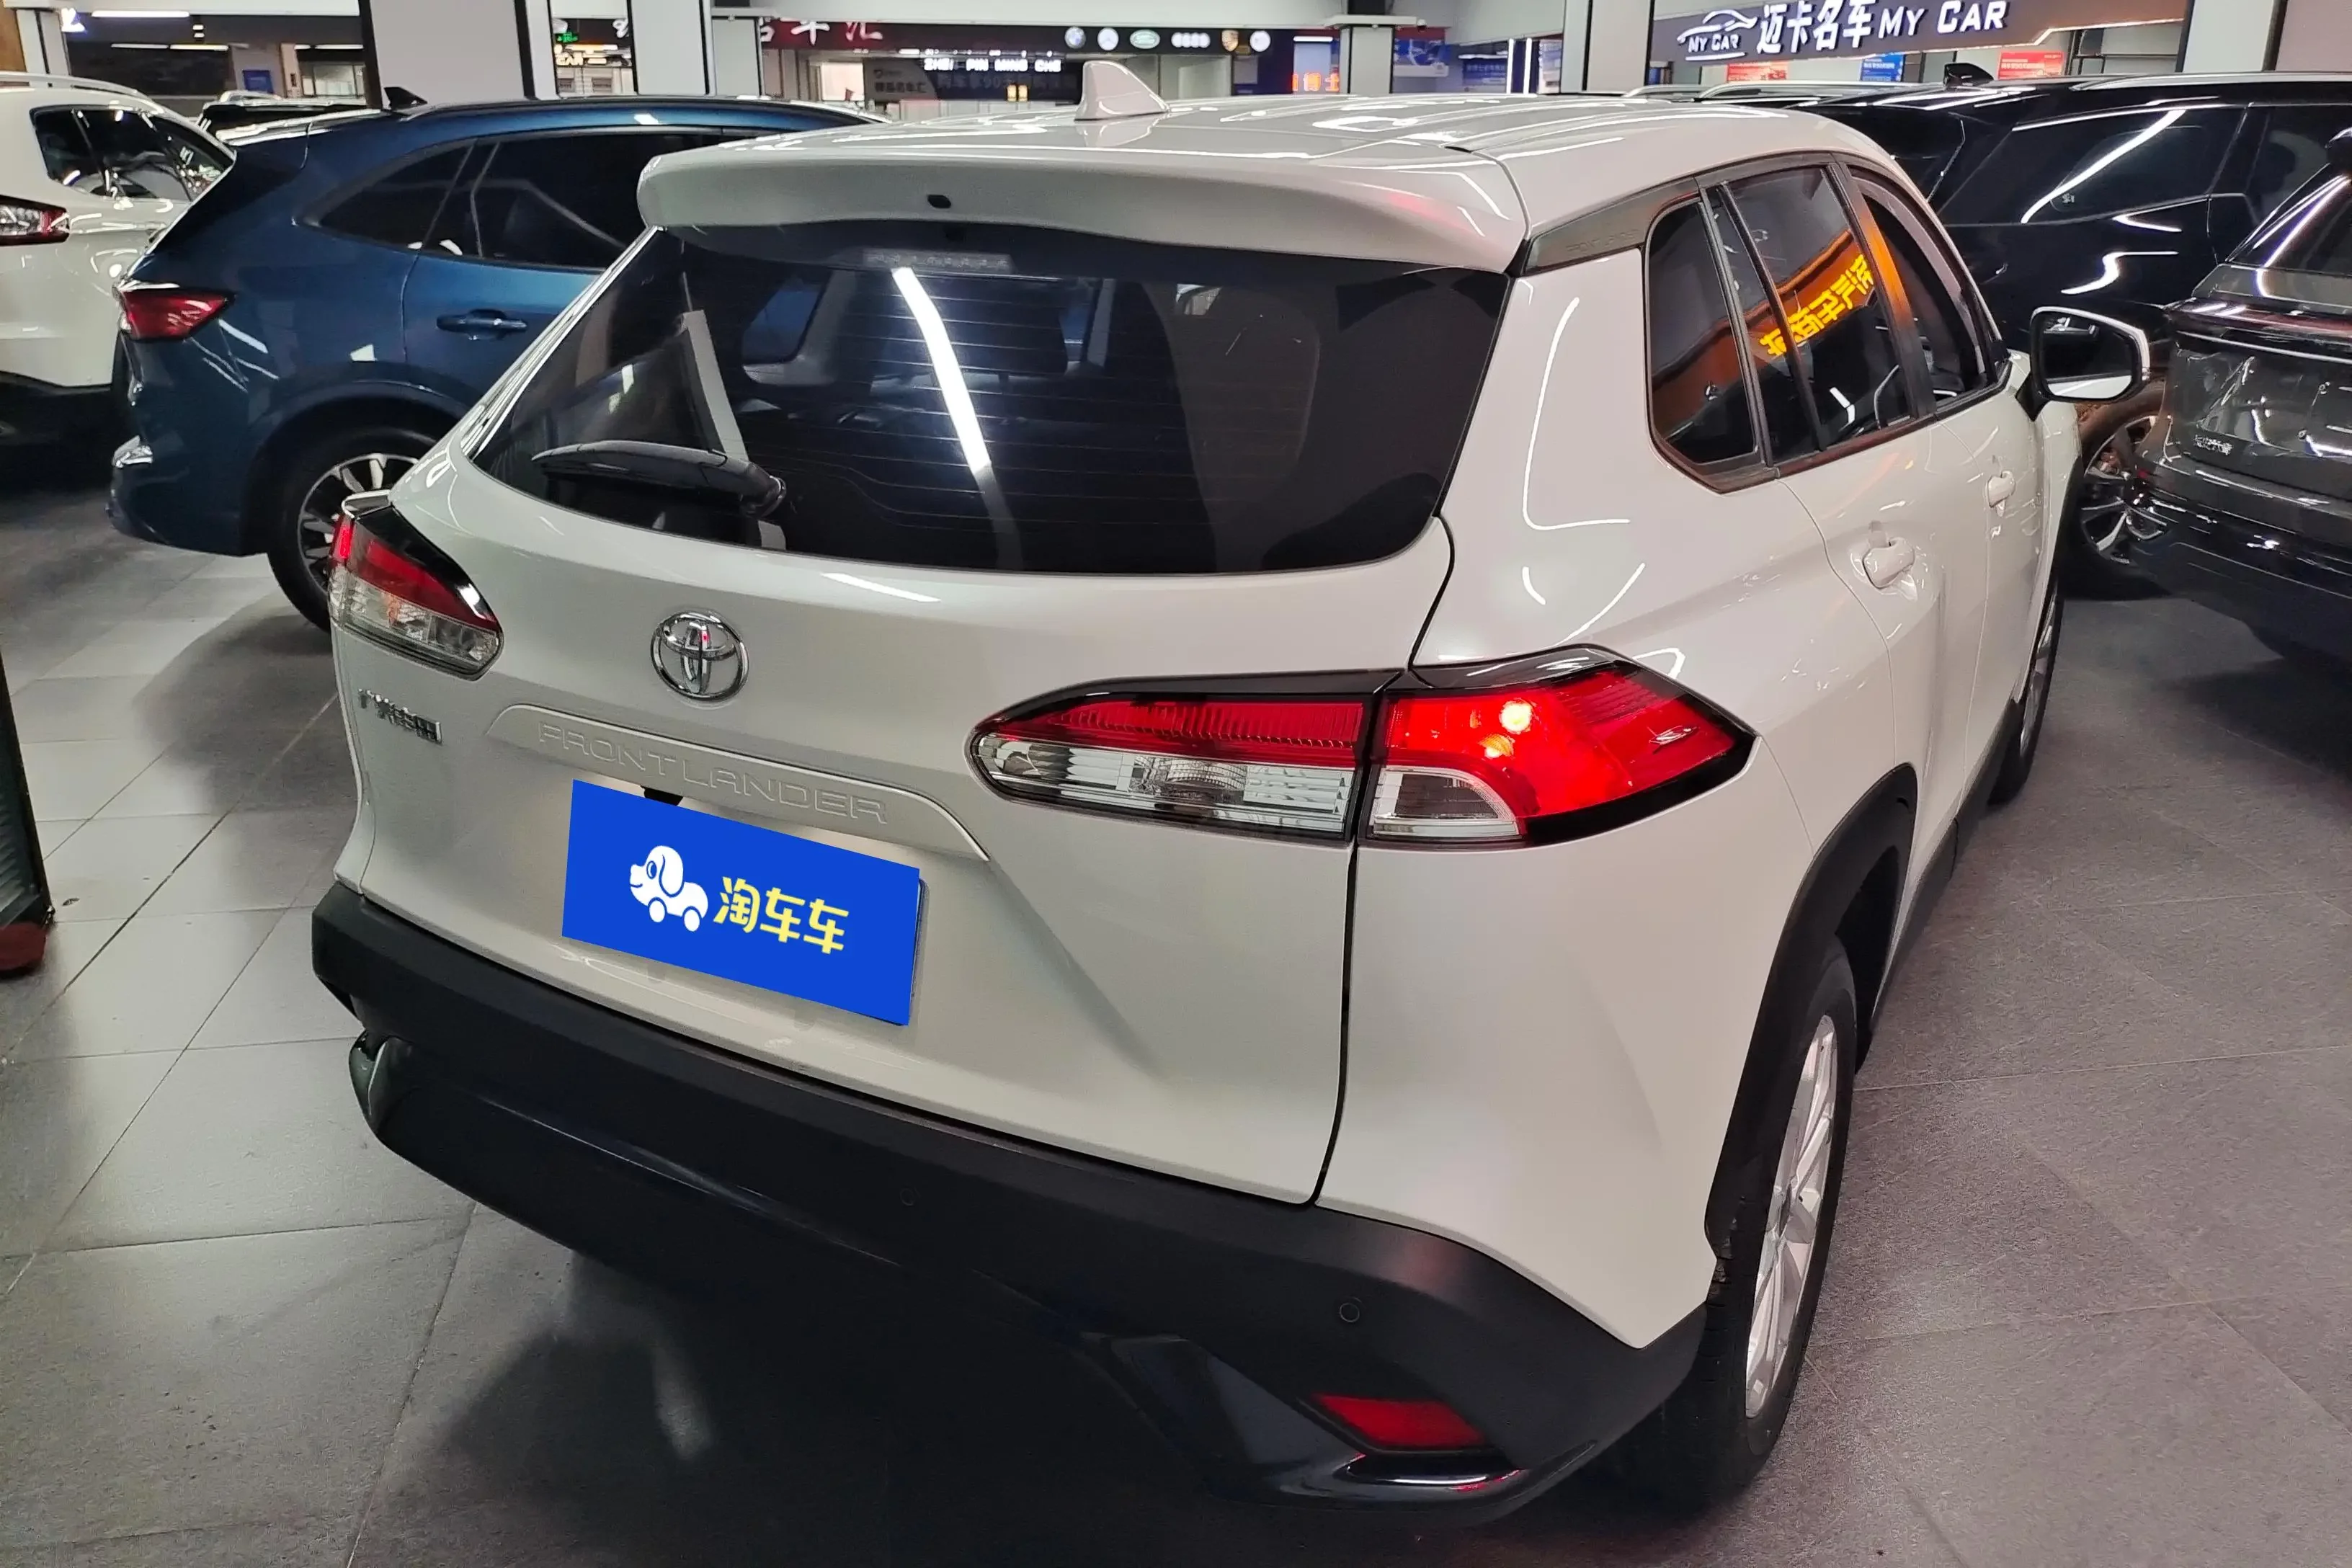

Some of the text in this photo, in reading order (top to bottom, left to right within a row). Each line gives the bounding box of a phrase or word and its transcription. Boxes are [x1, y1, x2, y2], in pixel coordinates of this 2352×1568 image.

[1688, 33, 1739, 53] MY CAR
[1757, 0, 2008, 54] 迈卡名车 MY CAR
[538, 721, 888, 825] FRONTLANDER
